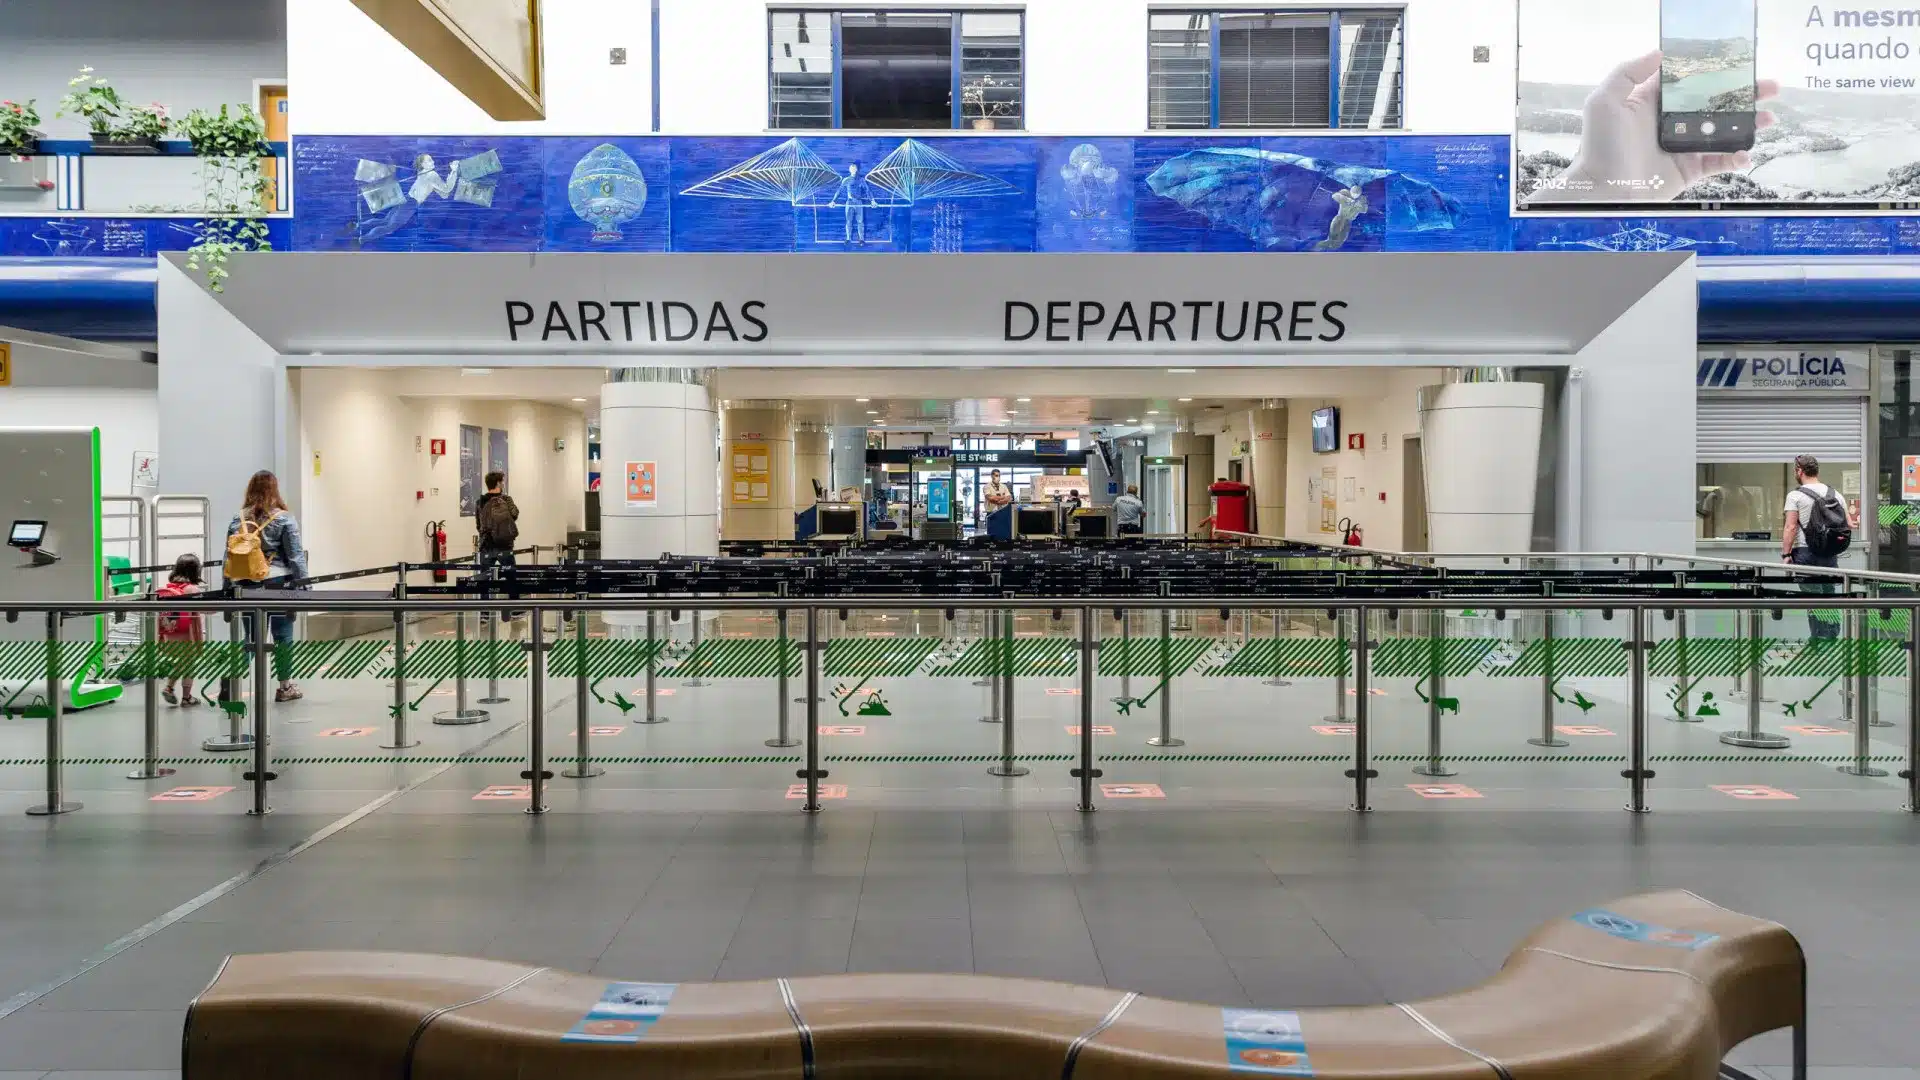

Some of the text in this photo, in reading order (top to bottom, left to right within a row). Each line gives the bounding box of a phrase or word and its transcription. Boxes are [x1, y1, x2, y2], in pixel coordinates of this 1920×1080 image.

[1806, 5, 1824, 27] A
[1806, 36, 1909, 66] quando
[1805, 75, 1916, 88] The same view
[505, 300, 769, 342] PARTIDAS
[1003, 300, 1349, 342] DEPARTURES
[1751, 353, 1846, 376] POLÍCIA
[1752, 377, 1847, 388] SEGURANÇA PÚBLICA
